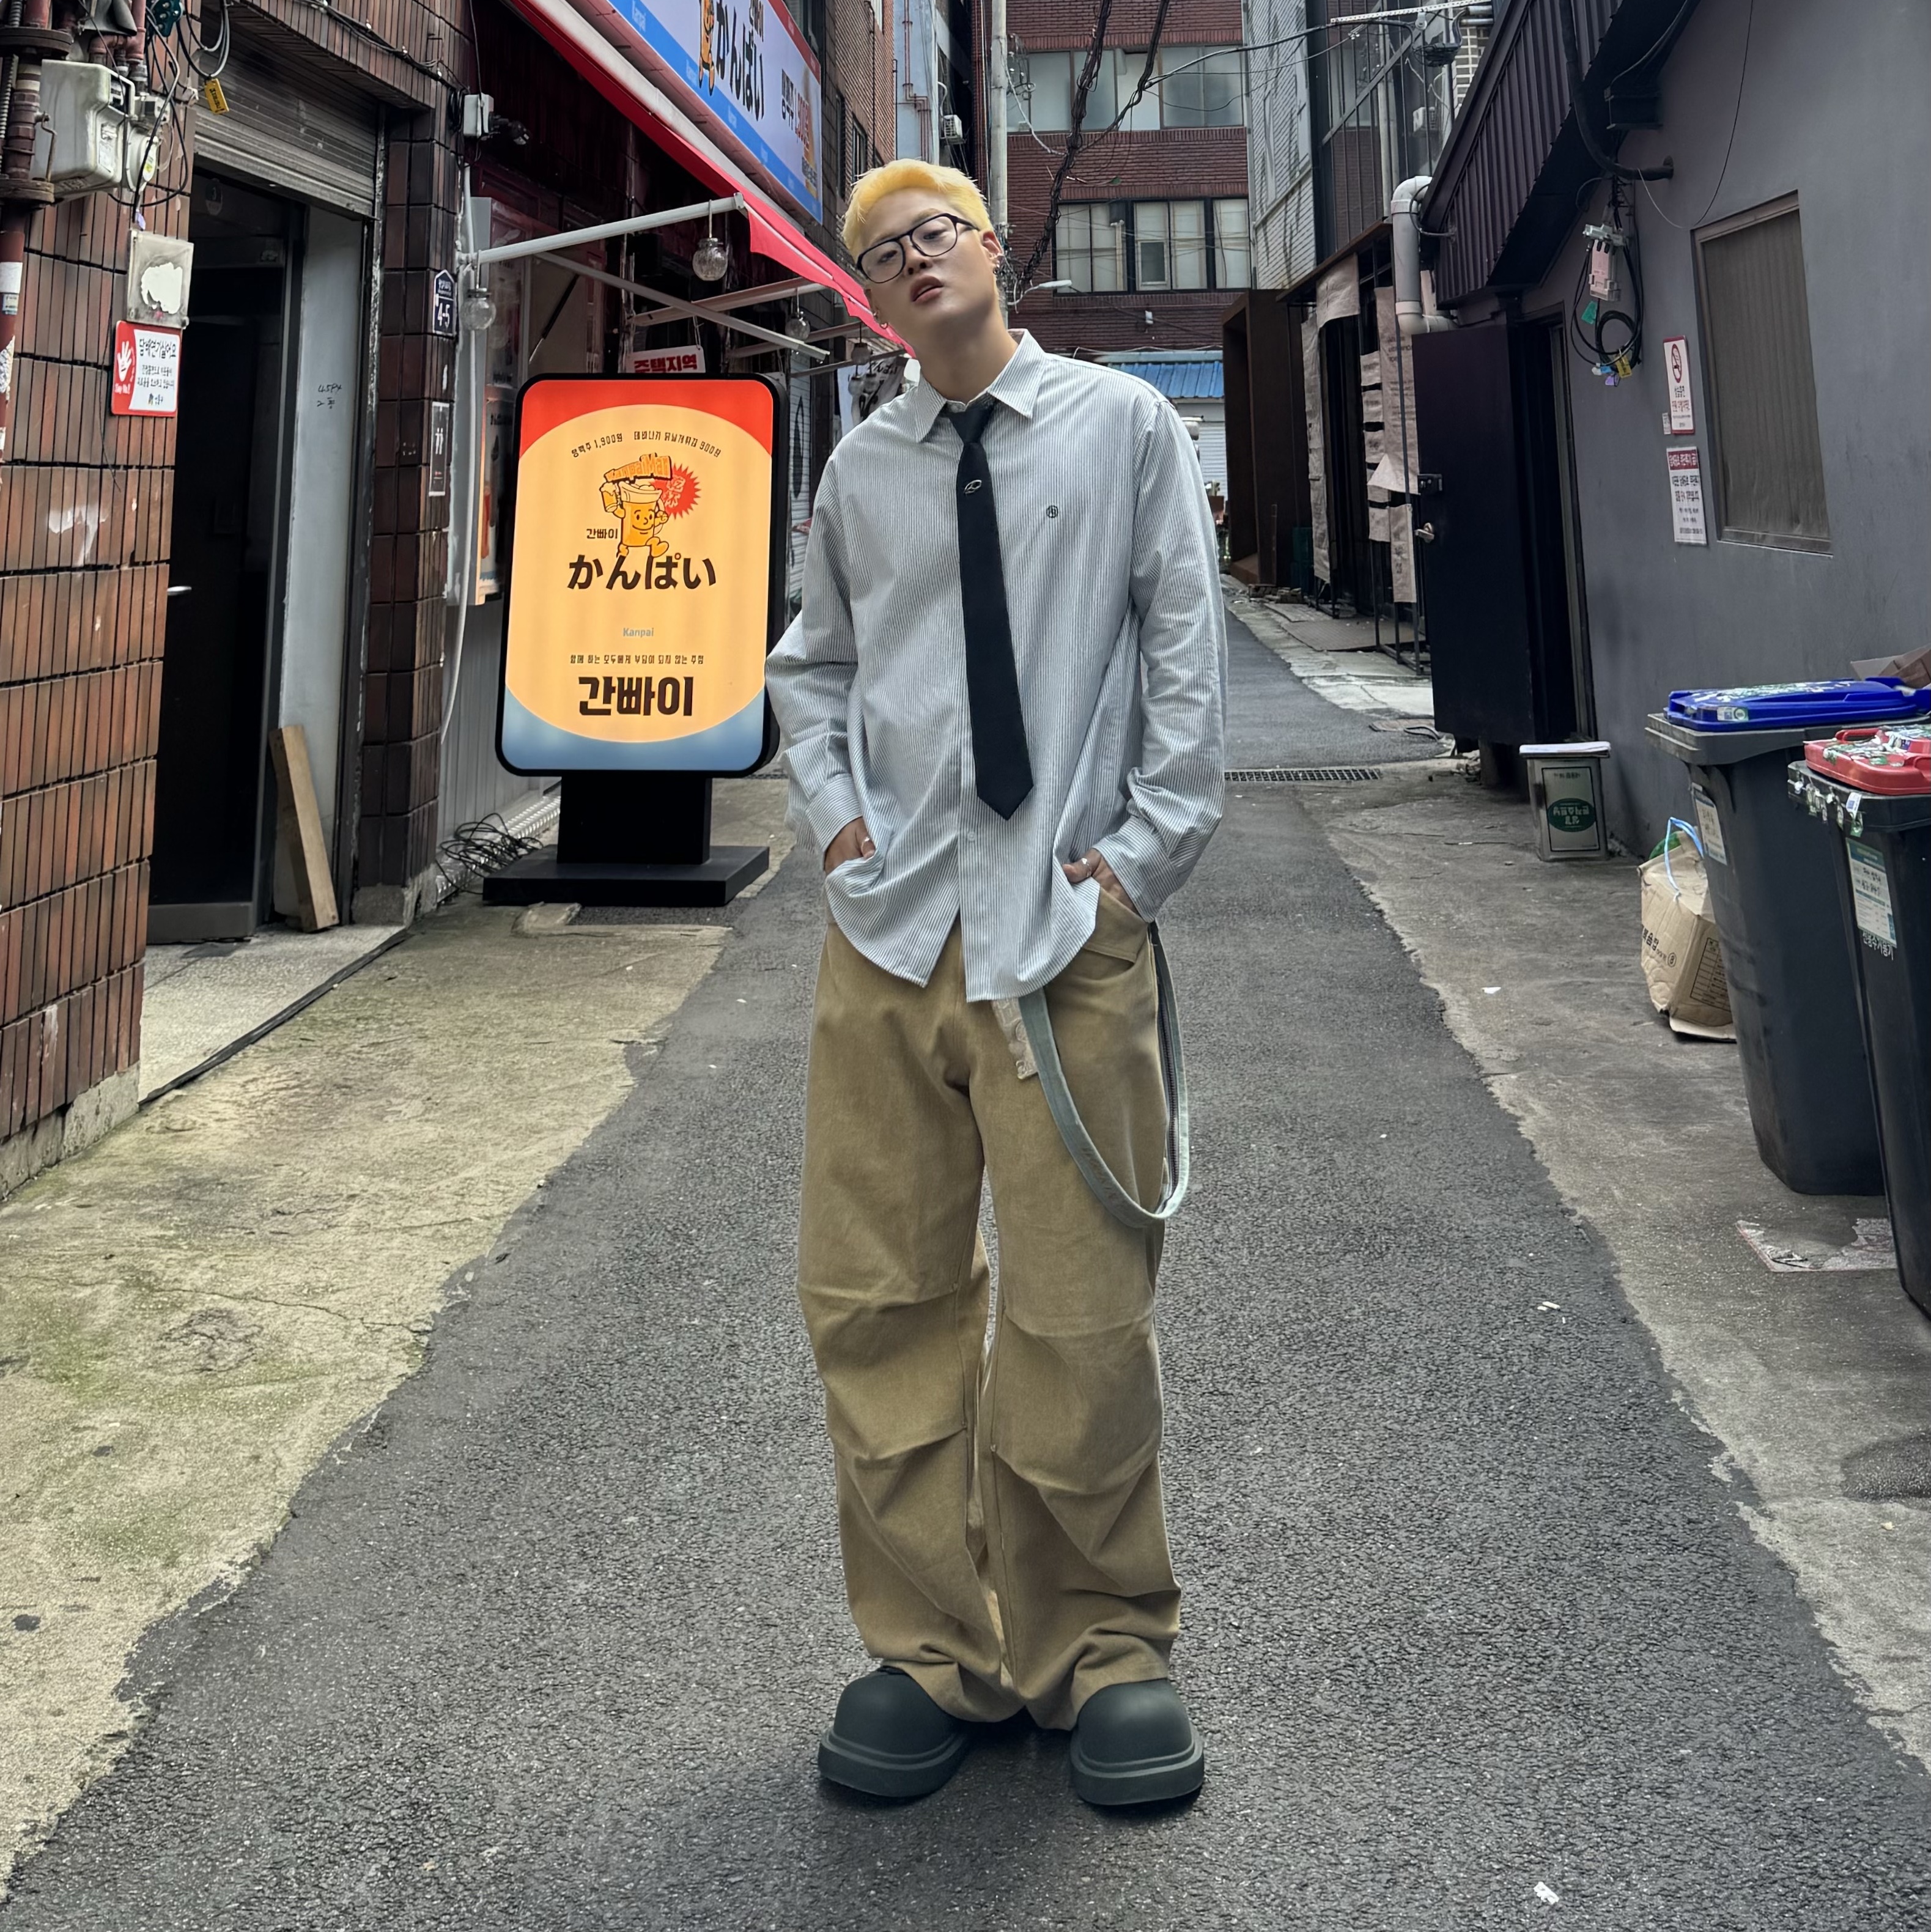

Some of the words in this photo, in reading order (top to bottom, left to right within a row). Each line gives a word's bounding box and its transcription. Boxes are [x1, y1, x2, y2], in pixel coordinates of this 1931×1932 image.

[437, 302, 451, 328] 4-5
[139, 338, 176, 359] 담배연기싫어요
[594, 433, 623, 449] 1,900원
[700, 441, 722, 457] 900원
[586, 528, 618, 539] 간빠이
[567, 552, 716, 590] かんぱい
[623, 627, 654, 638] Kanpai
[588, 655, 600, 664] 하는
[604, 655, 631, 664] 모두에게
[578, 676, 694, 716] 간빠이
